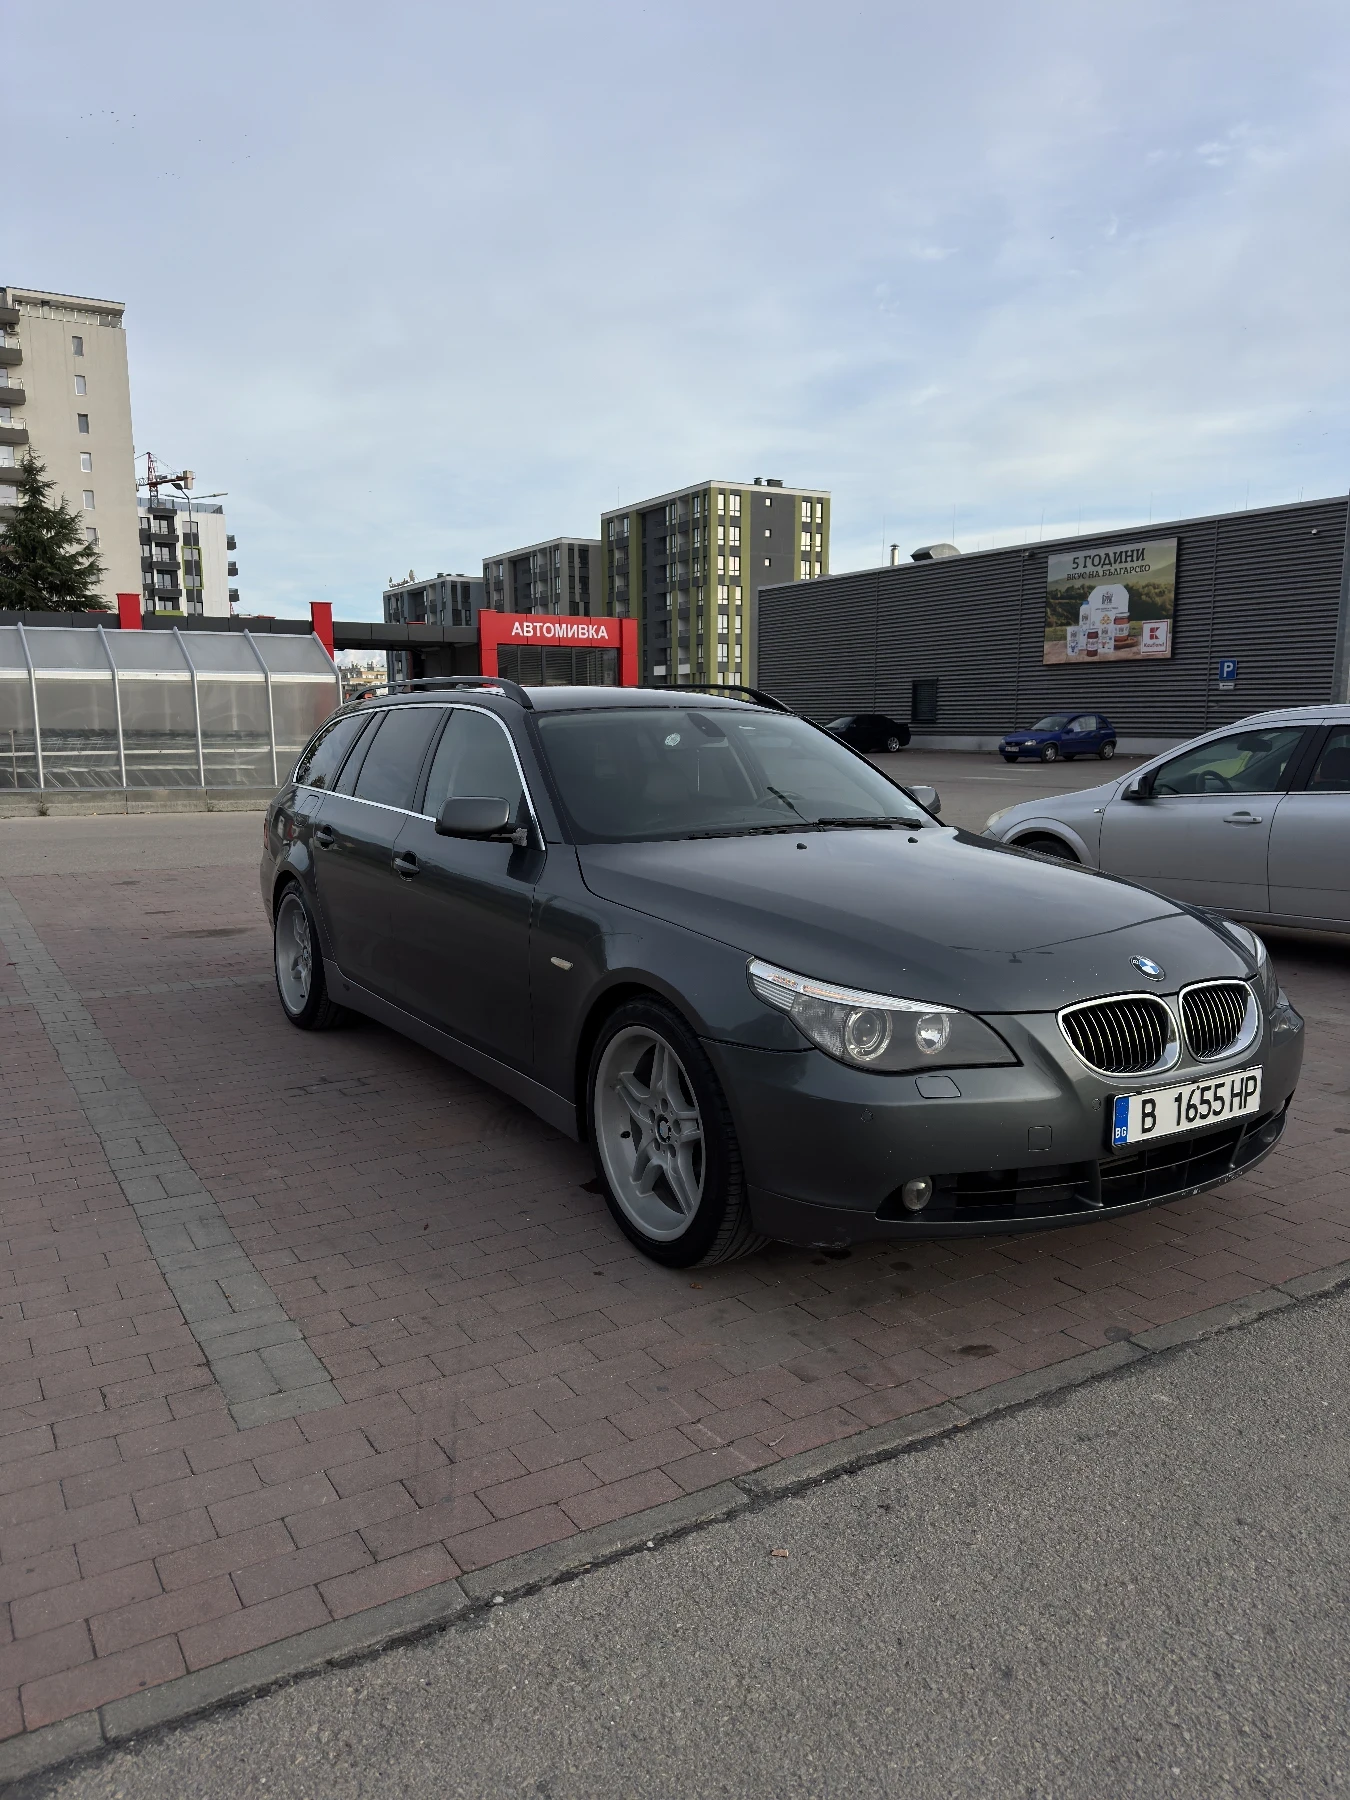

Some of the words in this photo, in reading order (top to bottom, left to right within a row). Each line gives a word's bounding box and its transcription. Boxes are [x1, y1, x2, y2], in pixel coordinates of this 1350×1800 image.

[1072, 557, 1079, 569] 5
[1083, 548, 1145, 568] ГОДИНИ
[1066, 572, 1087, 581] ВКУС
[1088, 571, 1100, 579] НА
[1102, 564, 1151, 577] БЪЛГАРСКО
[512, 621, 608, 639] АВТОМИВКА
[1223, 662, 1234, 677] P
[1141, 1098, 1157, 1134] B
[1174, 1082, 1226, 1126] 1655
[1115, 1126, 1127, 1139] BG
